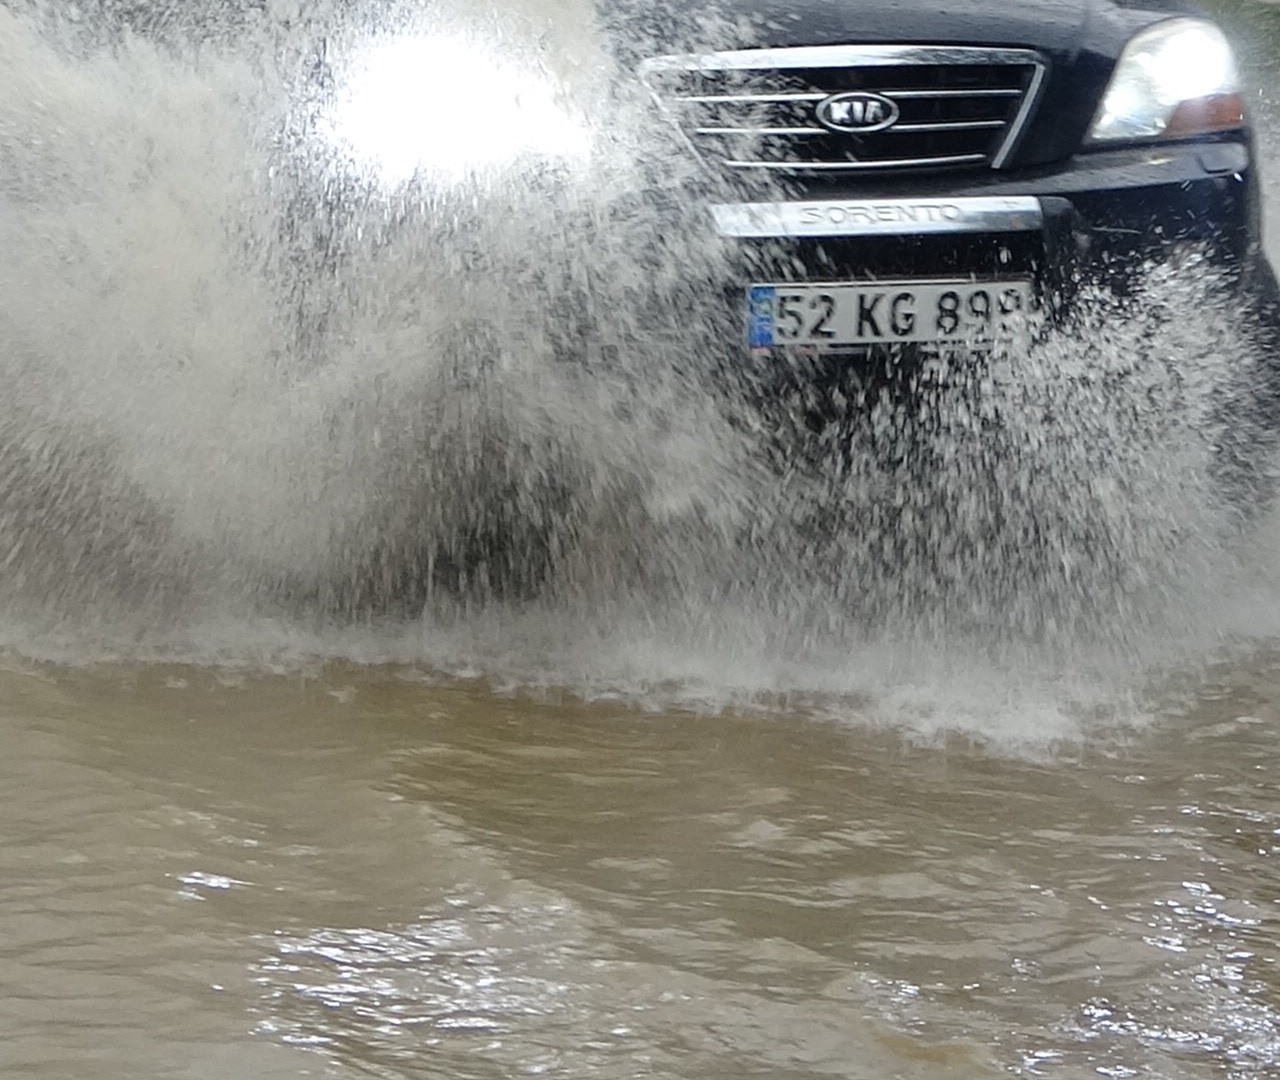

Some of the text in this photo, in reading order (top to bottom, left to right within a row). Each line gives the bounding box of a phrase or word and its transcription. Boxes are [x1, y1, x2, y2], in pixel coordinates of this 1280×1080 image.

[829, 100, 885, 124] KIA
[800, 204, 961, 225] SORENTO
[776, 294, 836, 339] 52
[856, 291, 917, 338] KG
